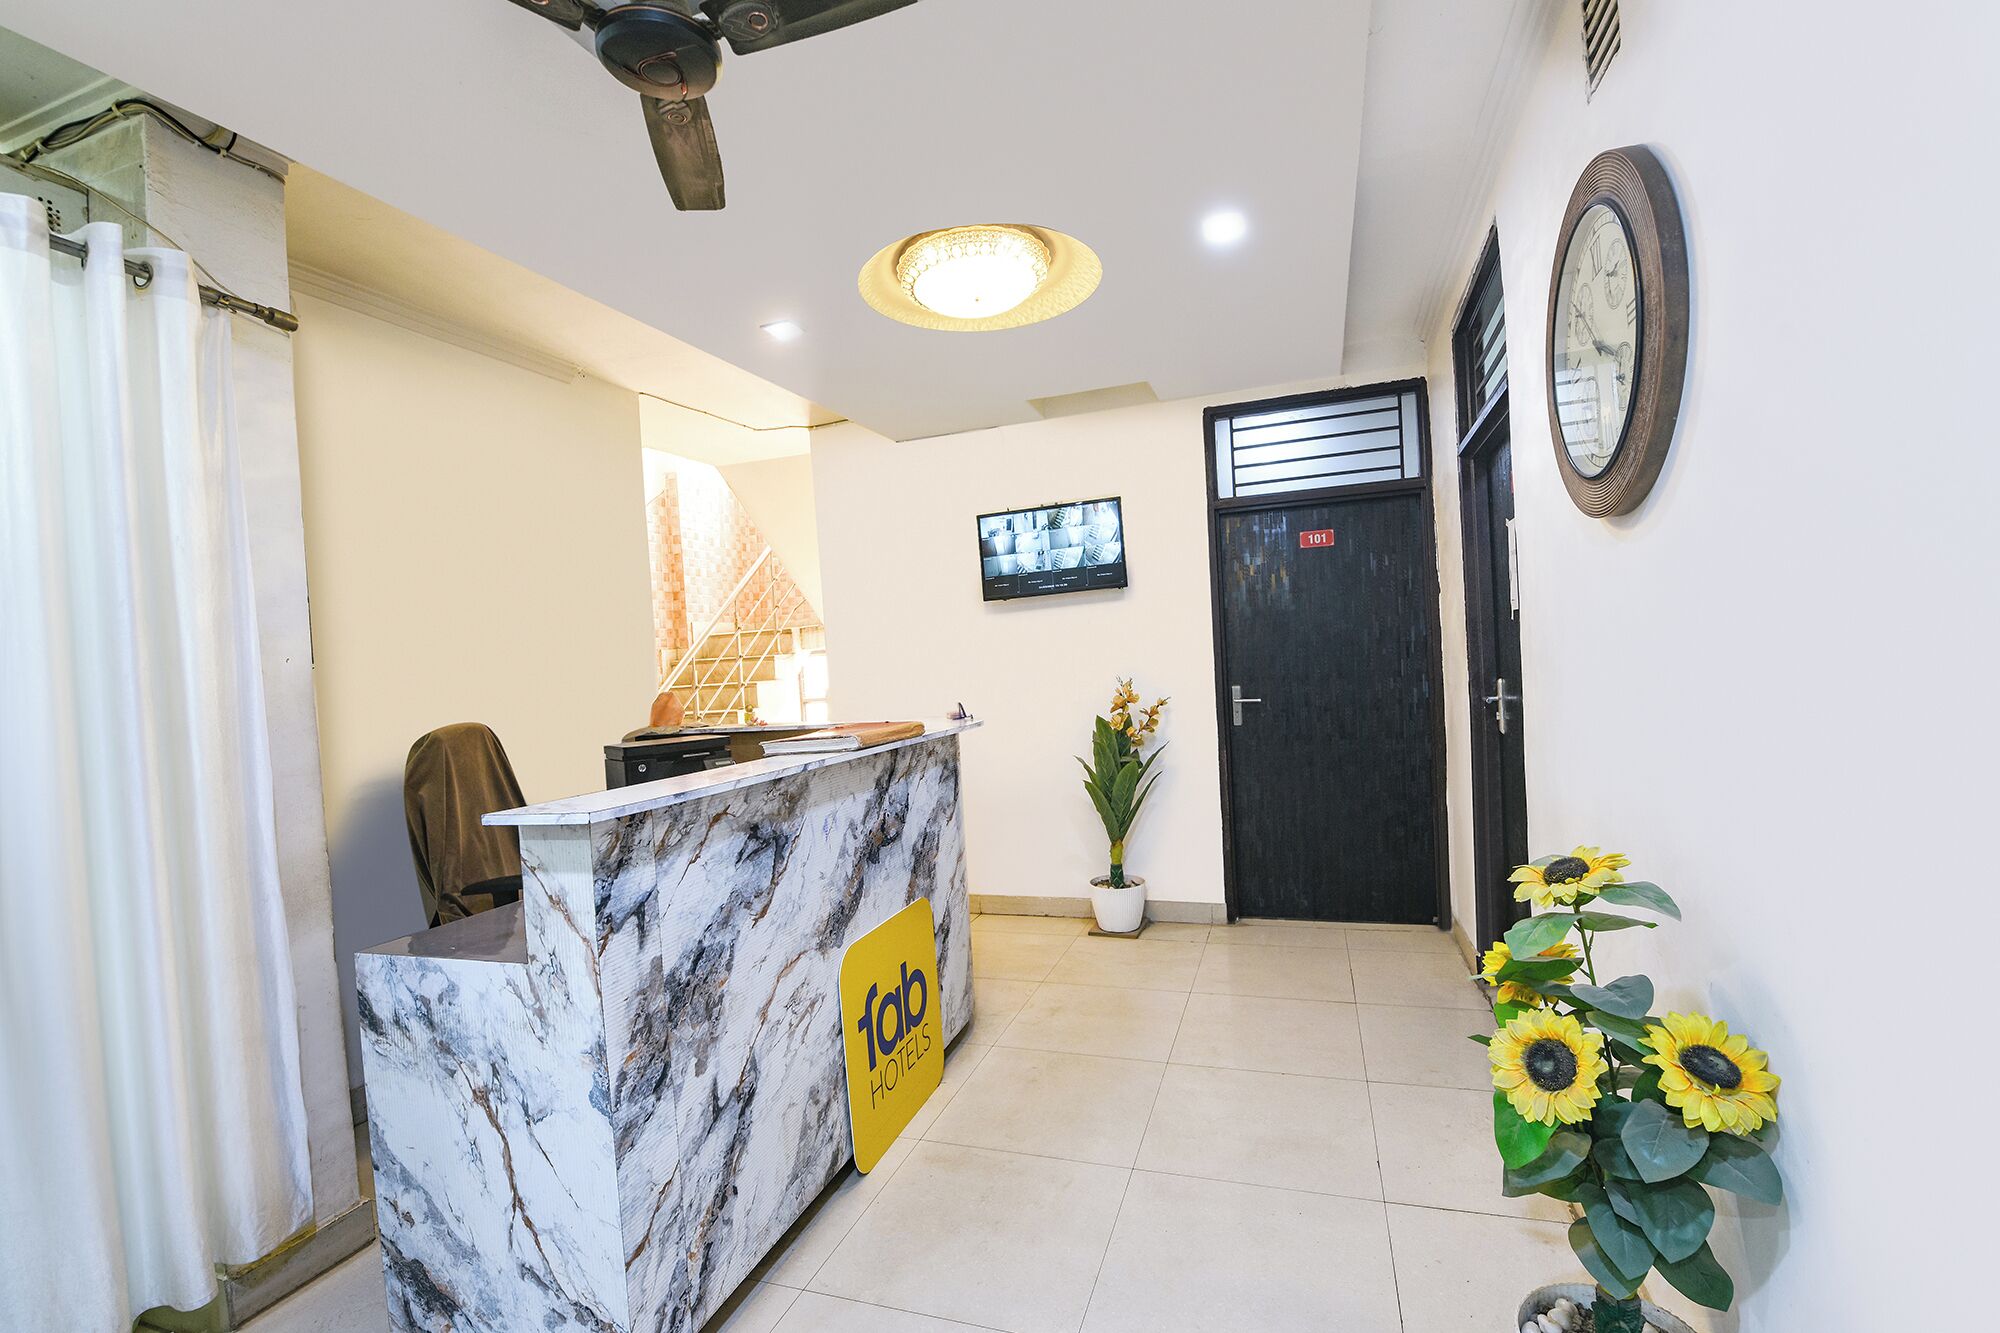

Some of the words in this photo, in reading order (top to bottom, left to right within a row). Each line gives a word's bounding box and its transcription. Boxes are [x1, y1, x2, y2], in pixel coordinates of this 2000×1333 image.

[1308, 533, 1327, 544] 101
[858, 961, 927, 1072] fab
[870, 1022, 932, 1110] HOTELS
